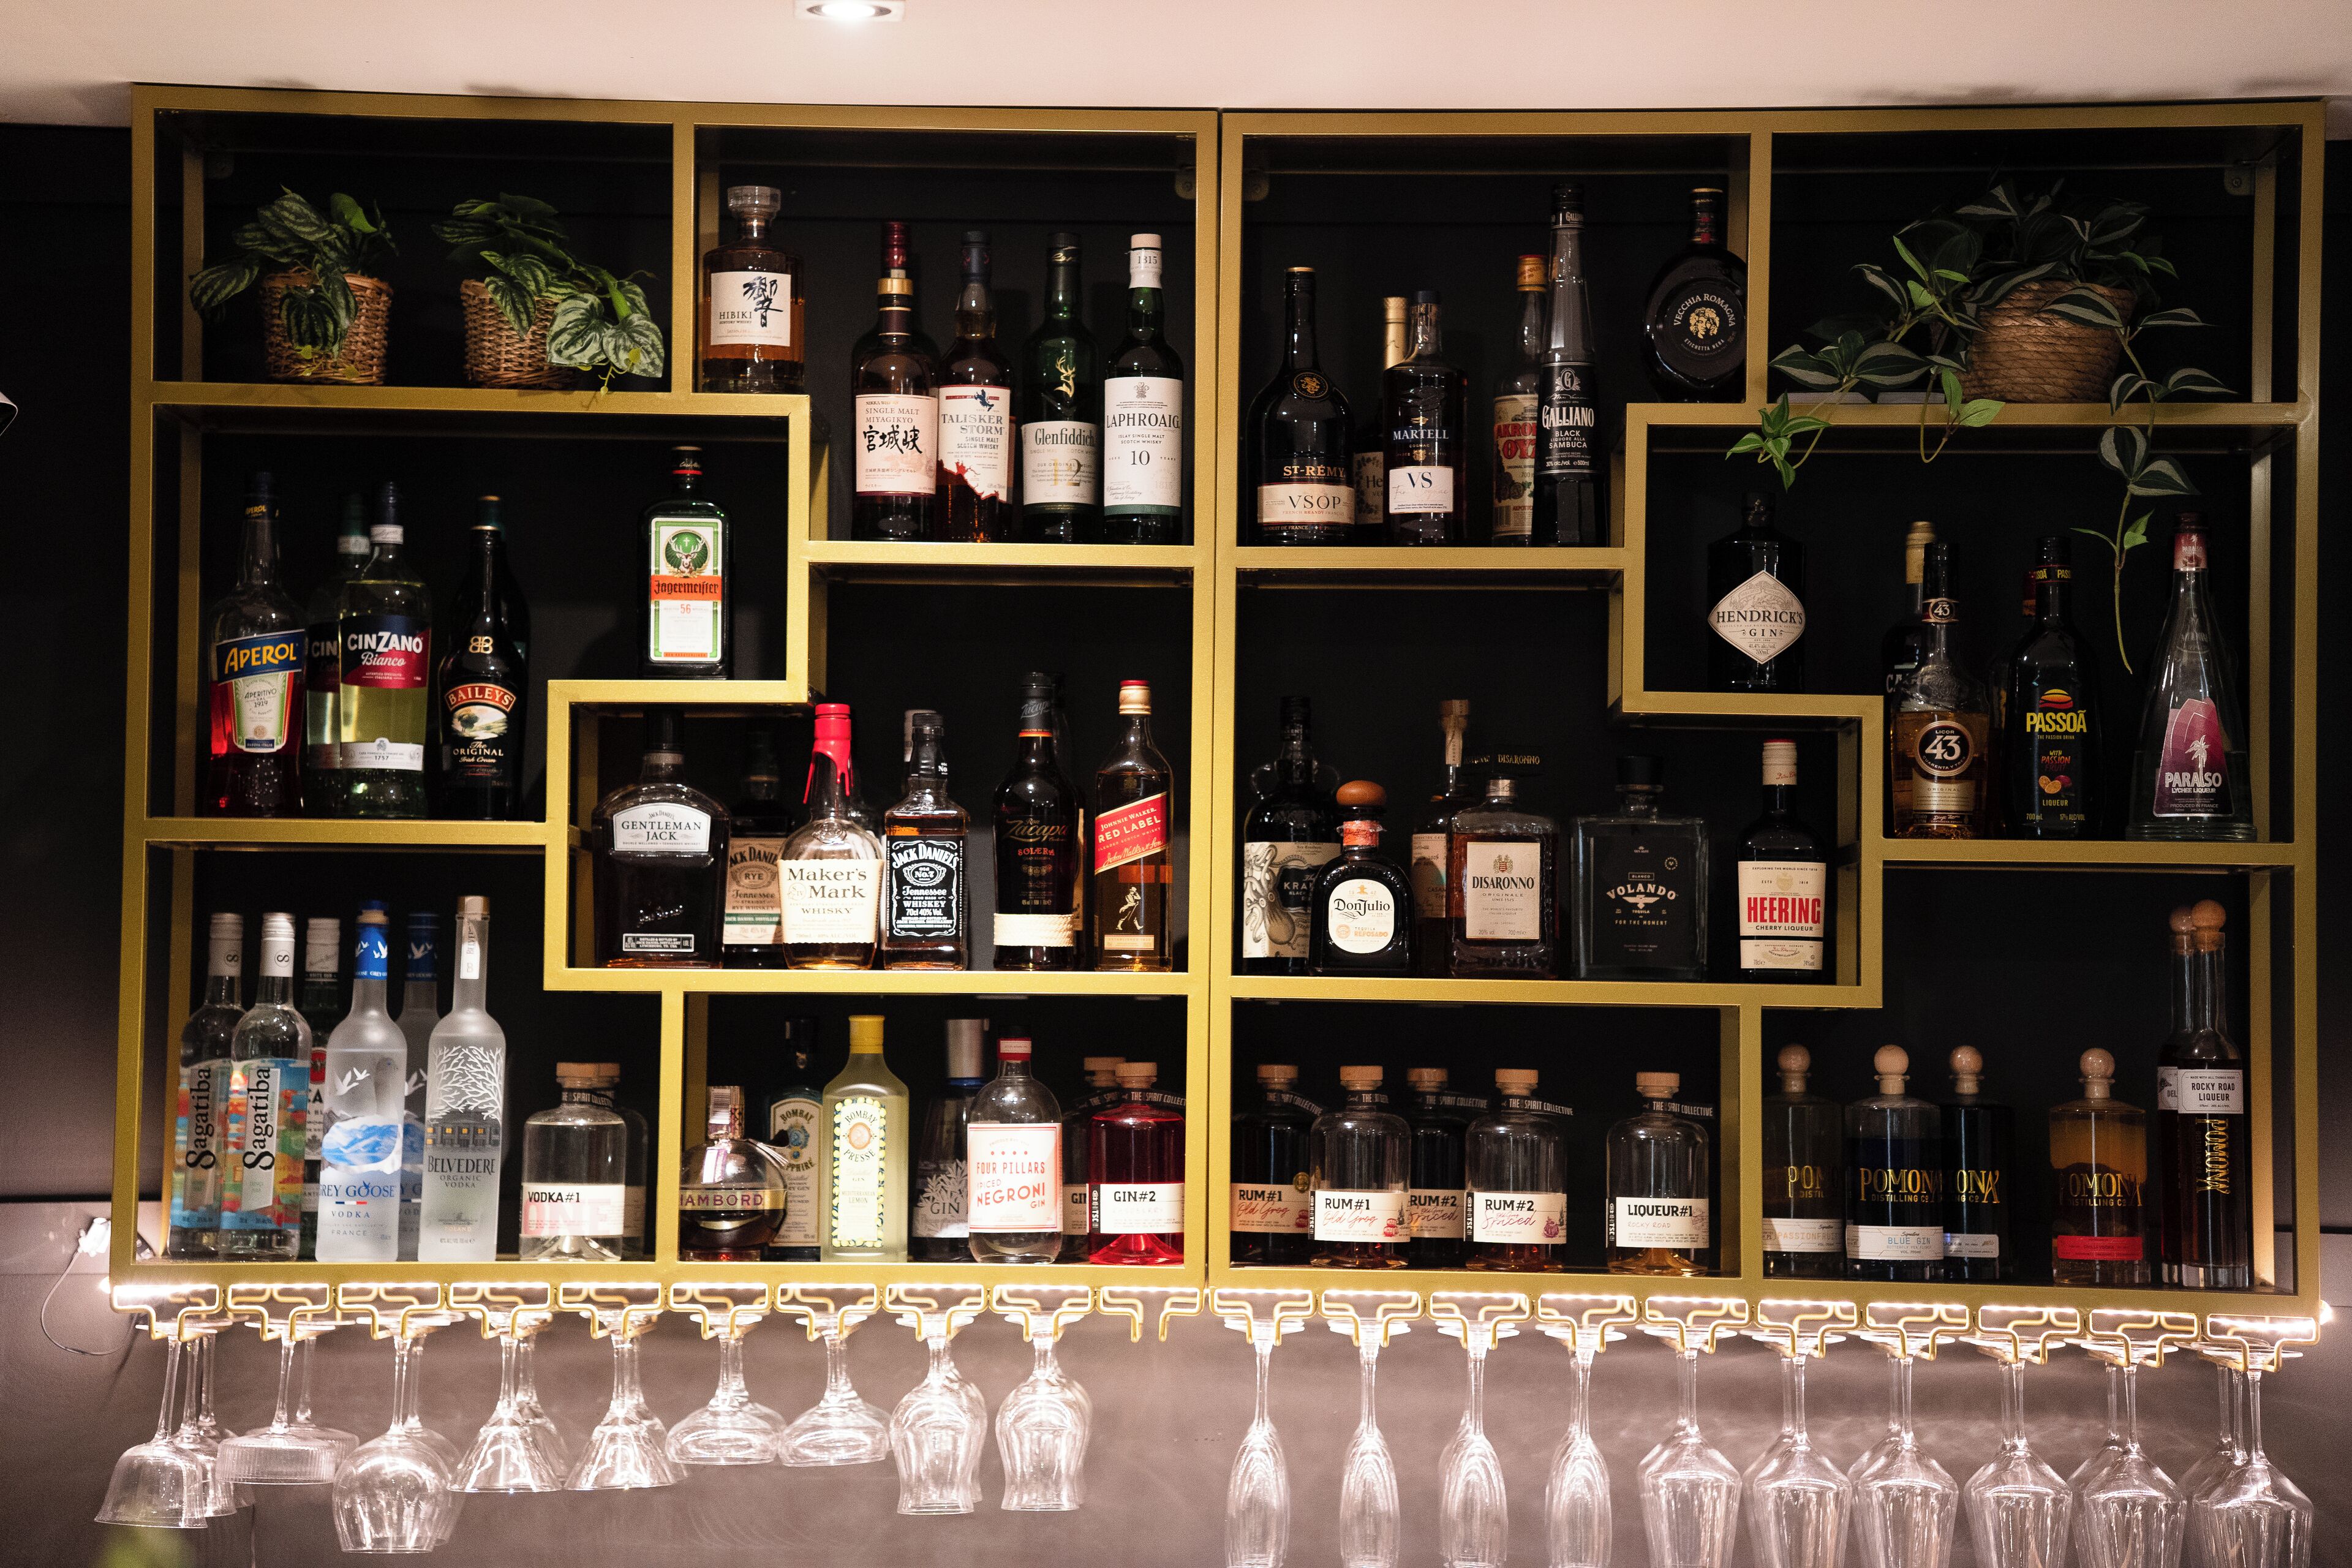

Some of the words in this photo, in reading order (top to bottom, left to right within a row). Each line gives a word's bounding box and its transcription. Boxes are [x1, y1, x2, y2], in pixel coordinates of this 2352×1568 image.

[1673, 295, 1702, 326] VECCHIA
[1704, 293, 1736, 327] ROMAGNA
[1684, 338, 1710, 351] ETICHETTA
[1712, 339, 1725, 350] NERA
[941, 414, 1003, 424] TALISKER
[1542, 405, 1594, 429] GALLIANO
[960, 425, 1003, 435] STORM
[1393, 429, 1449, 440] MARTELL
[1035, 428, 1095, 447] Glenfiddich
[1131, 450, 1150, 466] 10
[1283, 465, 1345, 477] ST-RÉMY
[1407, 472, 1433, 488] VS
[1289, 495, 1341, 510] VSOP
[680, 604, 691, 613] 56
[1934, 604, 1950, 616] 43
[1716, 610, 1804, 624] HENDRICK'S
[347, 631, 423, 654] CINZANO
[225, 643, 296, 674] APEROL
[361, 652, 406, 667] Bianco
[245, 688, 277, 699] APERITIVO
[448, 687, 513, 706] BAILEYS
[2026, 710, 2087, 733] PASSOÃ
[470, 741, 487, 750] The
[1924, 735, 1961, 761] 43
[1498, 755, 1540, 765] DISARONNO
[1923, 756, 1949, 770] CUARENTA
[2041, 756, 2071, 764] PASSION
[621, 821, 701, 830] GENTLEMAN
[1006, 818, 1068, 842] Zacapa
[1098, 829, 1120, 843] RED
[1123, 815, 1161, 834] LABEL
[1101, 816, 1128, 831] JOHNNIE
[646, 831, 677, 842] JACK
[891, 848, 918, 869] JACK
[918, 843, 960, 869] DANIEL'S
[787, 868, 867, 881] Maker's
[1472, 876, 1535, 890] DISARONNO
[732, 889, 775, 899] Tennessee
[810, 885, 866, 898] Mark
[902, 886, 947, 895] Tennessee
[1606, 883, 1677, 900] VOLANDO
[1334, 899, 1361, 911] Don
[1357, 899, 1390, 916] Julio
[1747, 897, 1821, 925] HEERING
[1131, 1091, 1142, 1101] THE
[1146, 1093, 1163, 1102] SPIRIT
[1362, 1093, 1372, 1102] THE
[1509, 1098, 1520, 1108] THE
[1524, 1099, 1542, 1110] SPIRIT
[1544, 1102, 1574, 1115] COLLECTIVE
[1653, 1101, 1664, 1110] THE
[1681, 1103, 1713, 1117] COLLECTIVE
[186, 1067, 216, 1170] Sagatiba
[243, 1067, 275, 1171] Sagatiba
[780, 1109, 814, 1123] BOMBAY
[845, 1110, 877, 1123] BOMBAY
[2195, 1117, 2230, 1194] POMONA
[428, 1156, 496, 1175] BELVEDERE
[977, 1163, 997, 1174] FOUR
[1003, 1162, 1045, 1174] PILLARS
[345, 1185, 395, 1197] GOOSE
[978, 1182, 1045, 1207] NEGRONI
[1114, 1191, 1156, 1202] GIN#2
[930, 1202, 960, 1214] GIN
[1030, 1199, 1045, 1208] GIN
[1628, 1204, 1693, 1217] LIQUEUR#1
[1323, 1210, 1346, 1226] Old
[1348, 1209, 1378, 1228] Grog
[1481, 1209, 1537, 1229] Spiced
